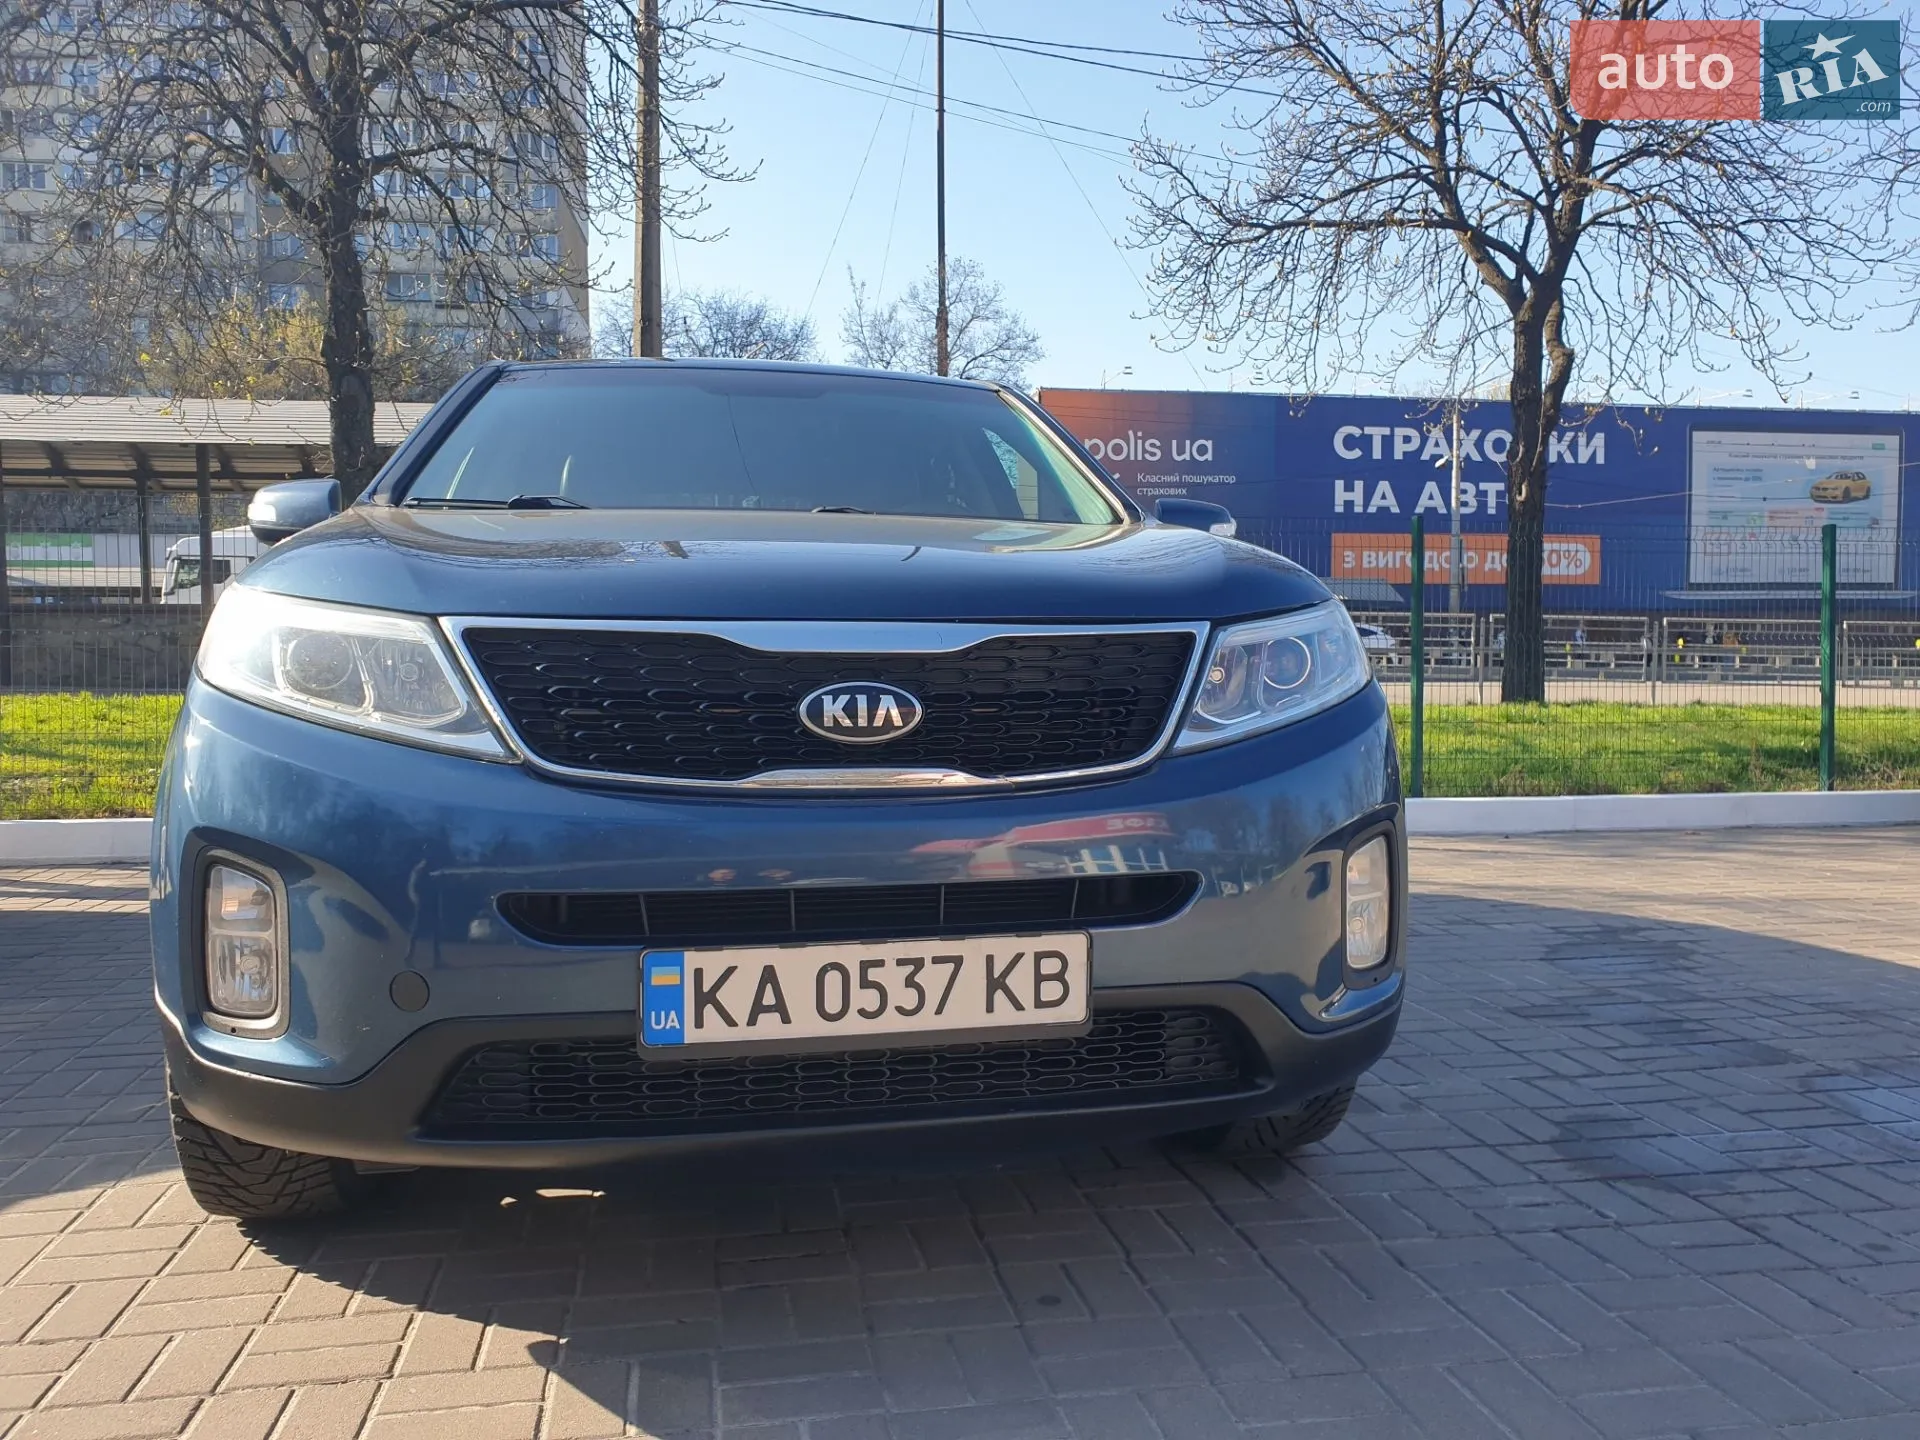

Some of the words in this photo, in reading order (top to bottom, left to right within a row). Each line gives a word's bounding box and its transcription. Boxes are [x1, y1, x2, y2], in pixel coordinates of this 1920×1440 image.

[1333, 425, 1605, 465] СТРАХОКИ
[1136, 471, 1179, 484] Класний
[1182, 473, 1236, 486] пошукатор
[1136, 486, 1187, 497] страхових
[1334, 479, 1400, 514] НА
[1414, 480, 1509, 515] АВТ
[1542, 549, 1583, 569] 0%
[822, 694, 904, 727] KIA
[693, 964, 792, 1030] KA
[815, 954, 964, 1023] 0537
[985, 949, 1070, 1014] KB
[650, 1010, 681, 1031] UA
